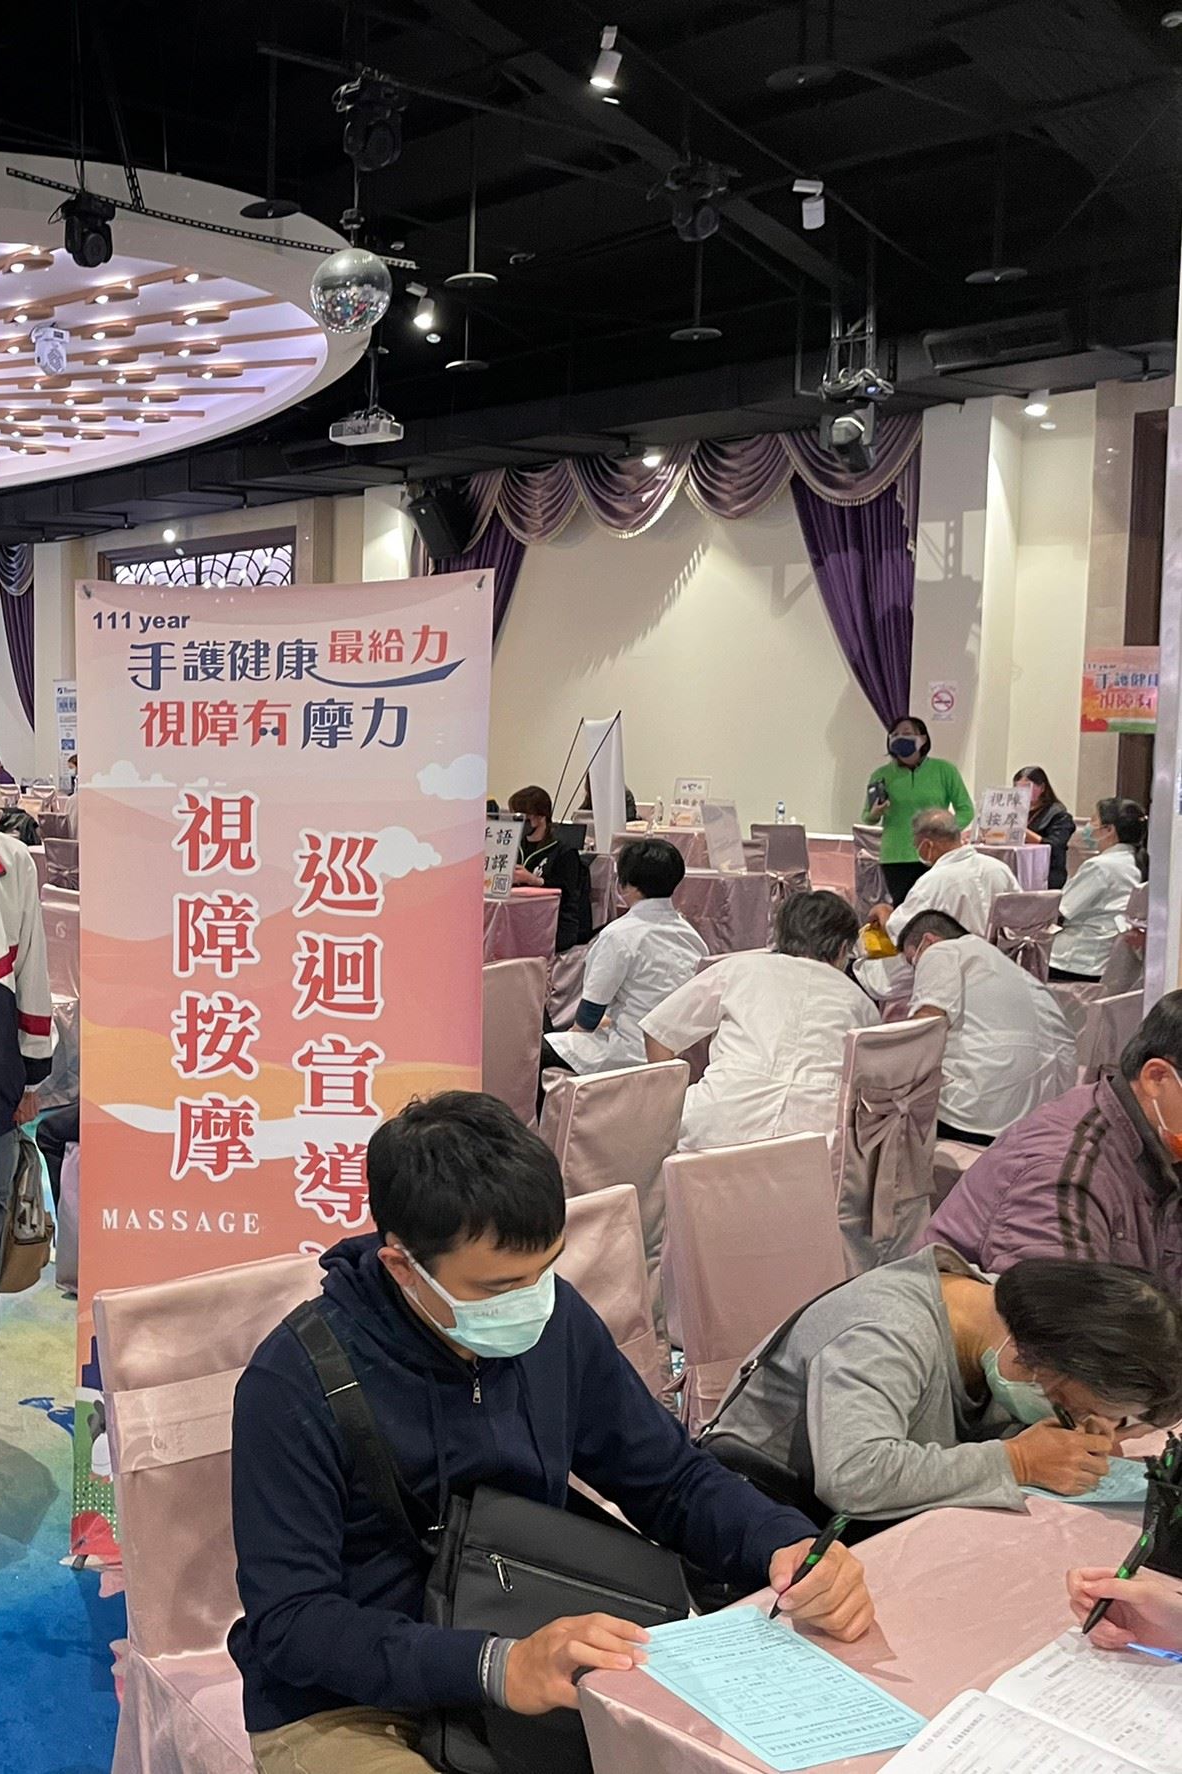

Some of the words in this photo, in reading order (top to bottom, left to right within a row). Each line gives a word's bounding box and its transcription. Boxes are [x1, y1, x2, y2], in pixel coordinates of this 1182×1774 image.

[93, 611, 131, 630] 111
[139, 613, 191, 634] year
[127, 624, 450, 691] 手護健康最給力
[139, 696, 408, 750] 視障有摩力
[485, 853, 509, 872] 譯
[175, 793, 257, 1177] 視障按摩
[299, 833, 379, 1255] 巡迴宣導
[101, 1207, 261, 1235] MASSAGE
